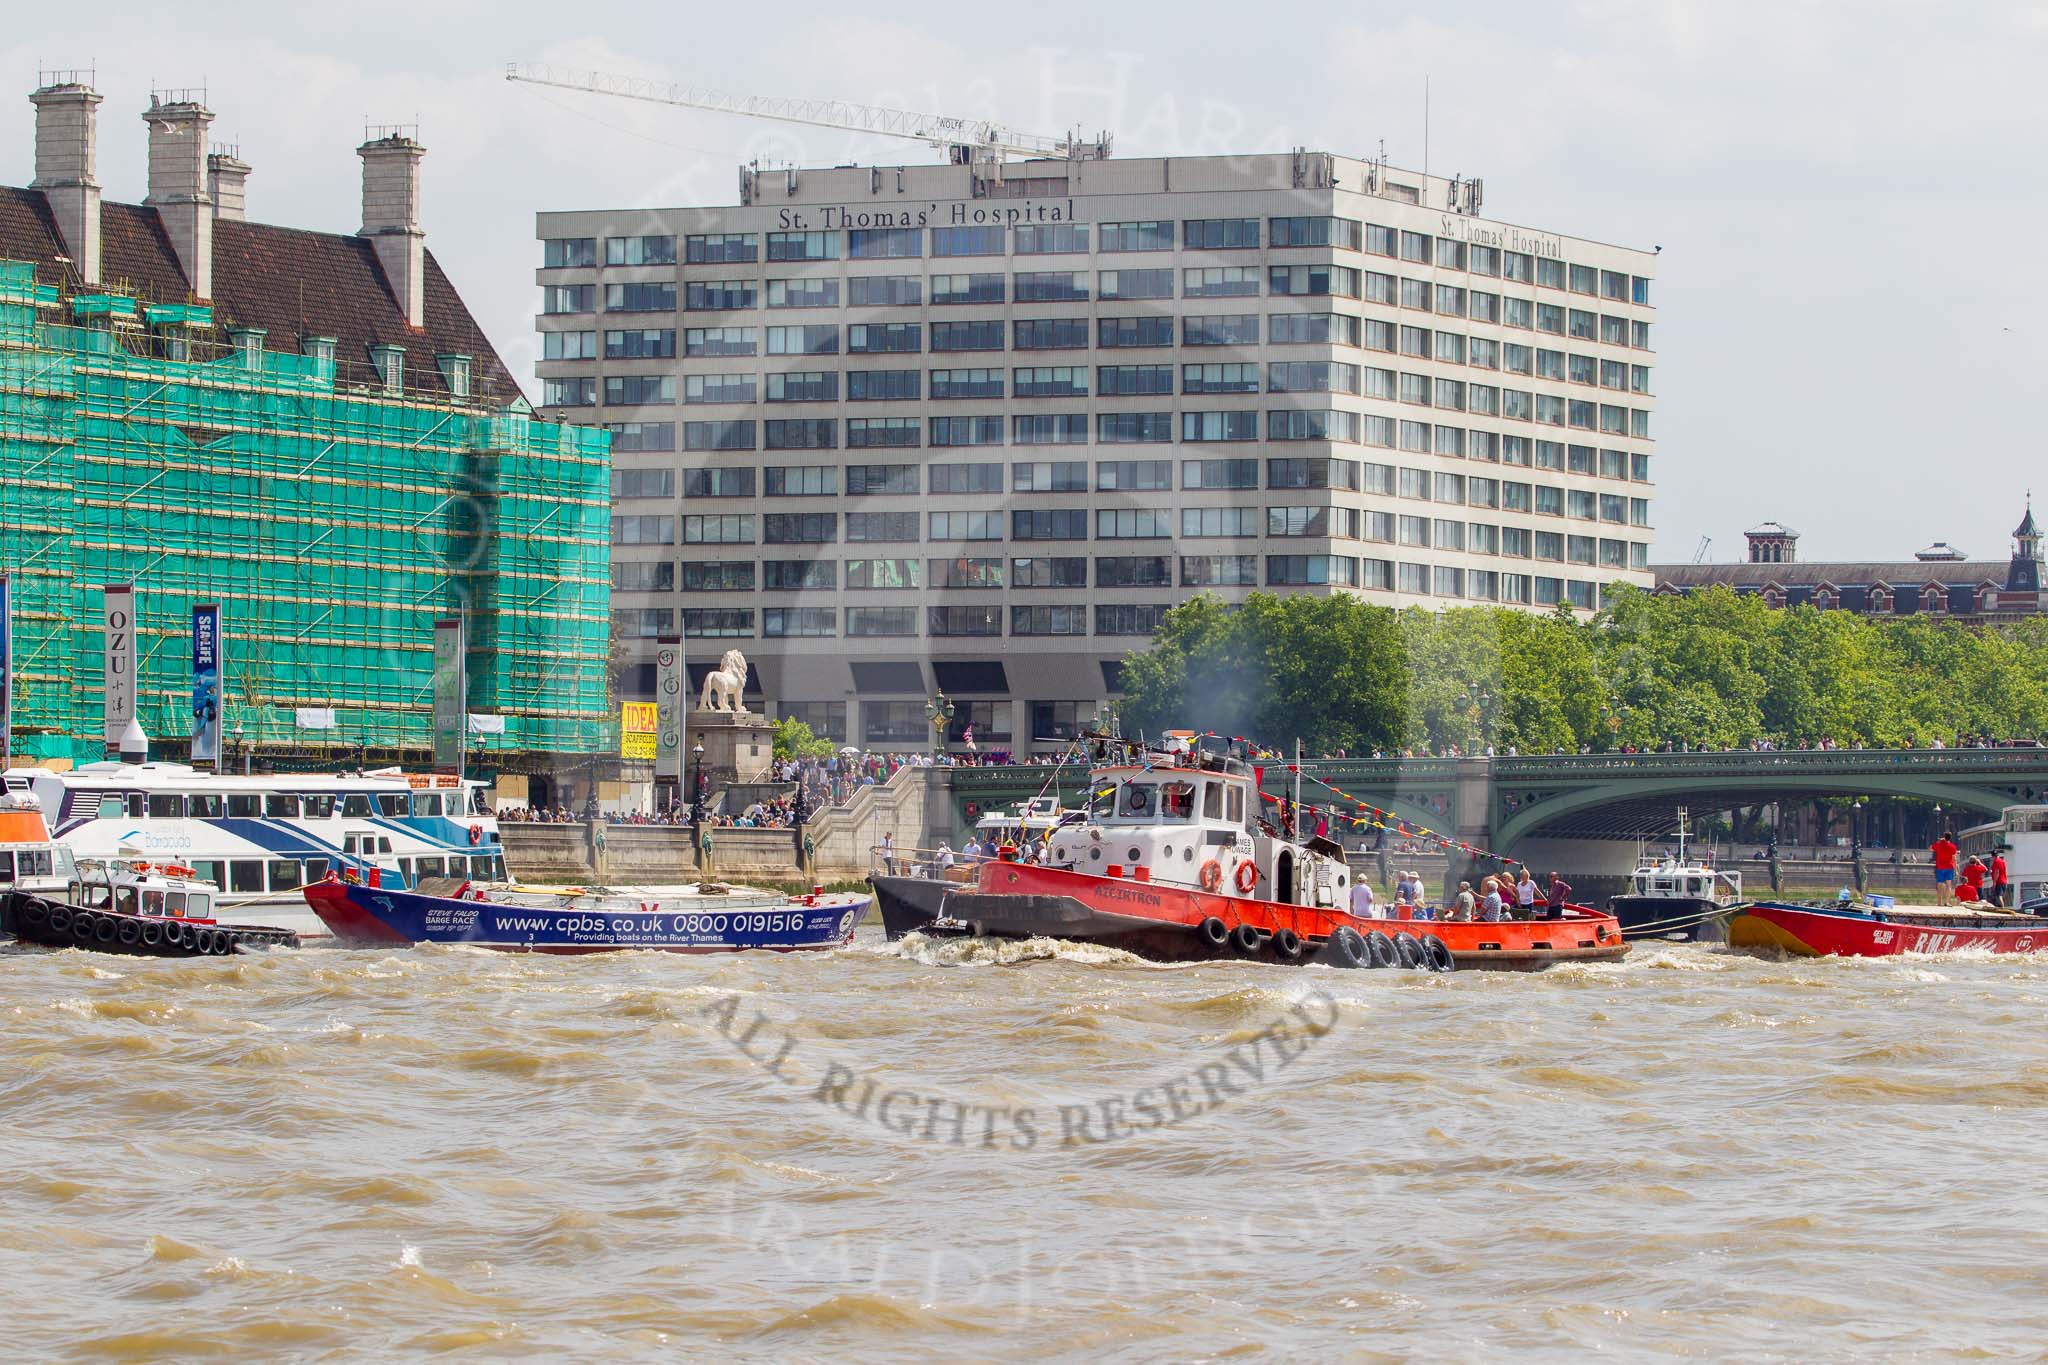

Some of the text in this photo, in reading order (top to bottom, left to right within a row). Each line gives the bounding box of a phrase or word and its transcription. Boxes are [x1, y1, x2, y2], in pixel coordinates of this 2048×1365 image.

[779, 207, 808, 230] St.
[951, 199, 1076, 230] Hospital
[1441, 214, 1455, 237] St.
[1512, 229, 1562, 260] Hospital
[109, 611, 127, 674] OZU
[427, 909, 453, 917] STEVE
[425, 916, 475, 925] BARGE RACE
[496, 913, 804, 936] www.cpbs.co.uk 0800 0191516
[843, 915, 850, 925] 2
[528, 933, 534, 941] 3
[574, 932, 724, 943] Providing boats on the River Thames
